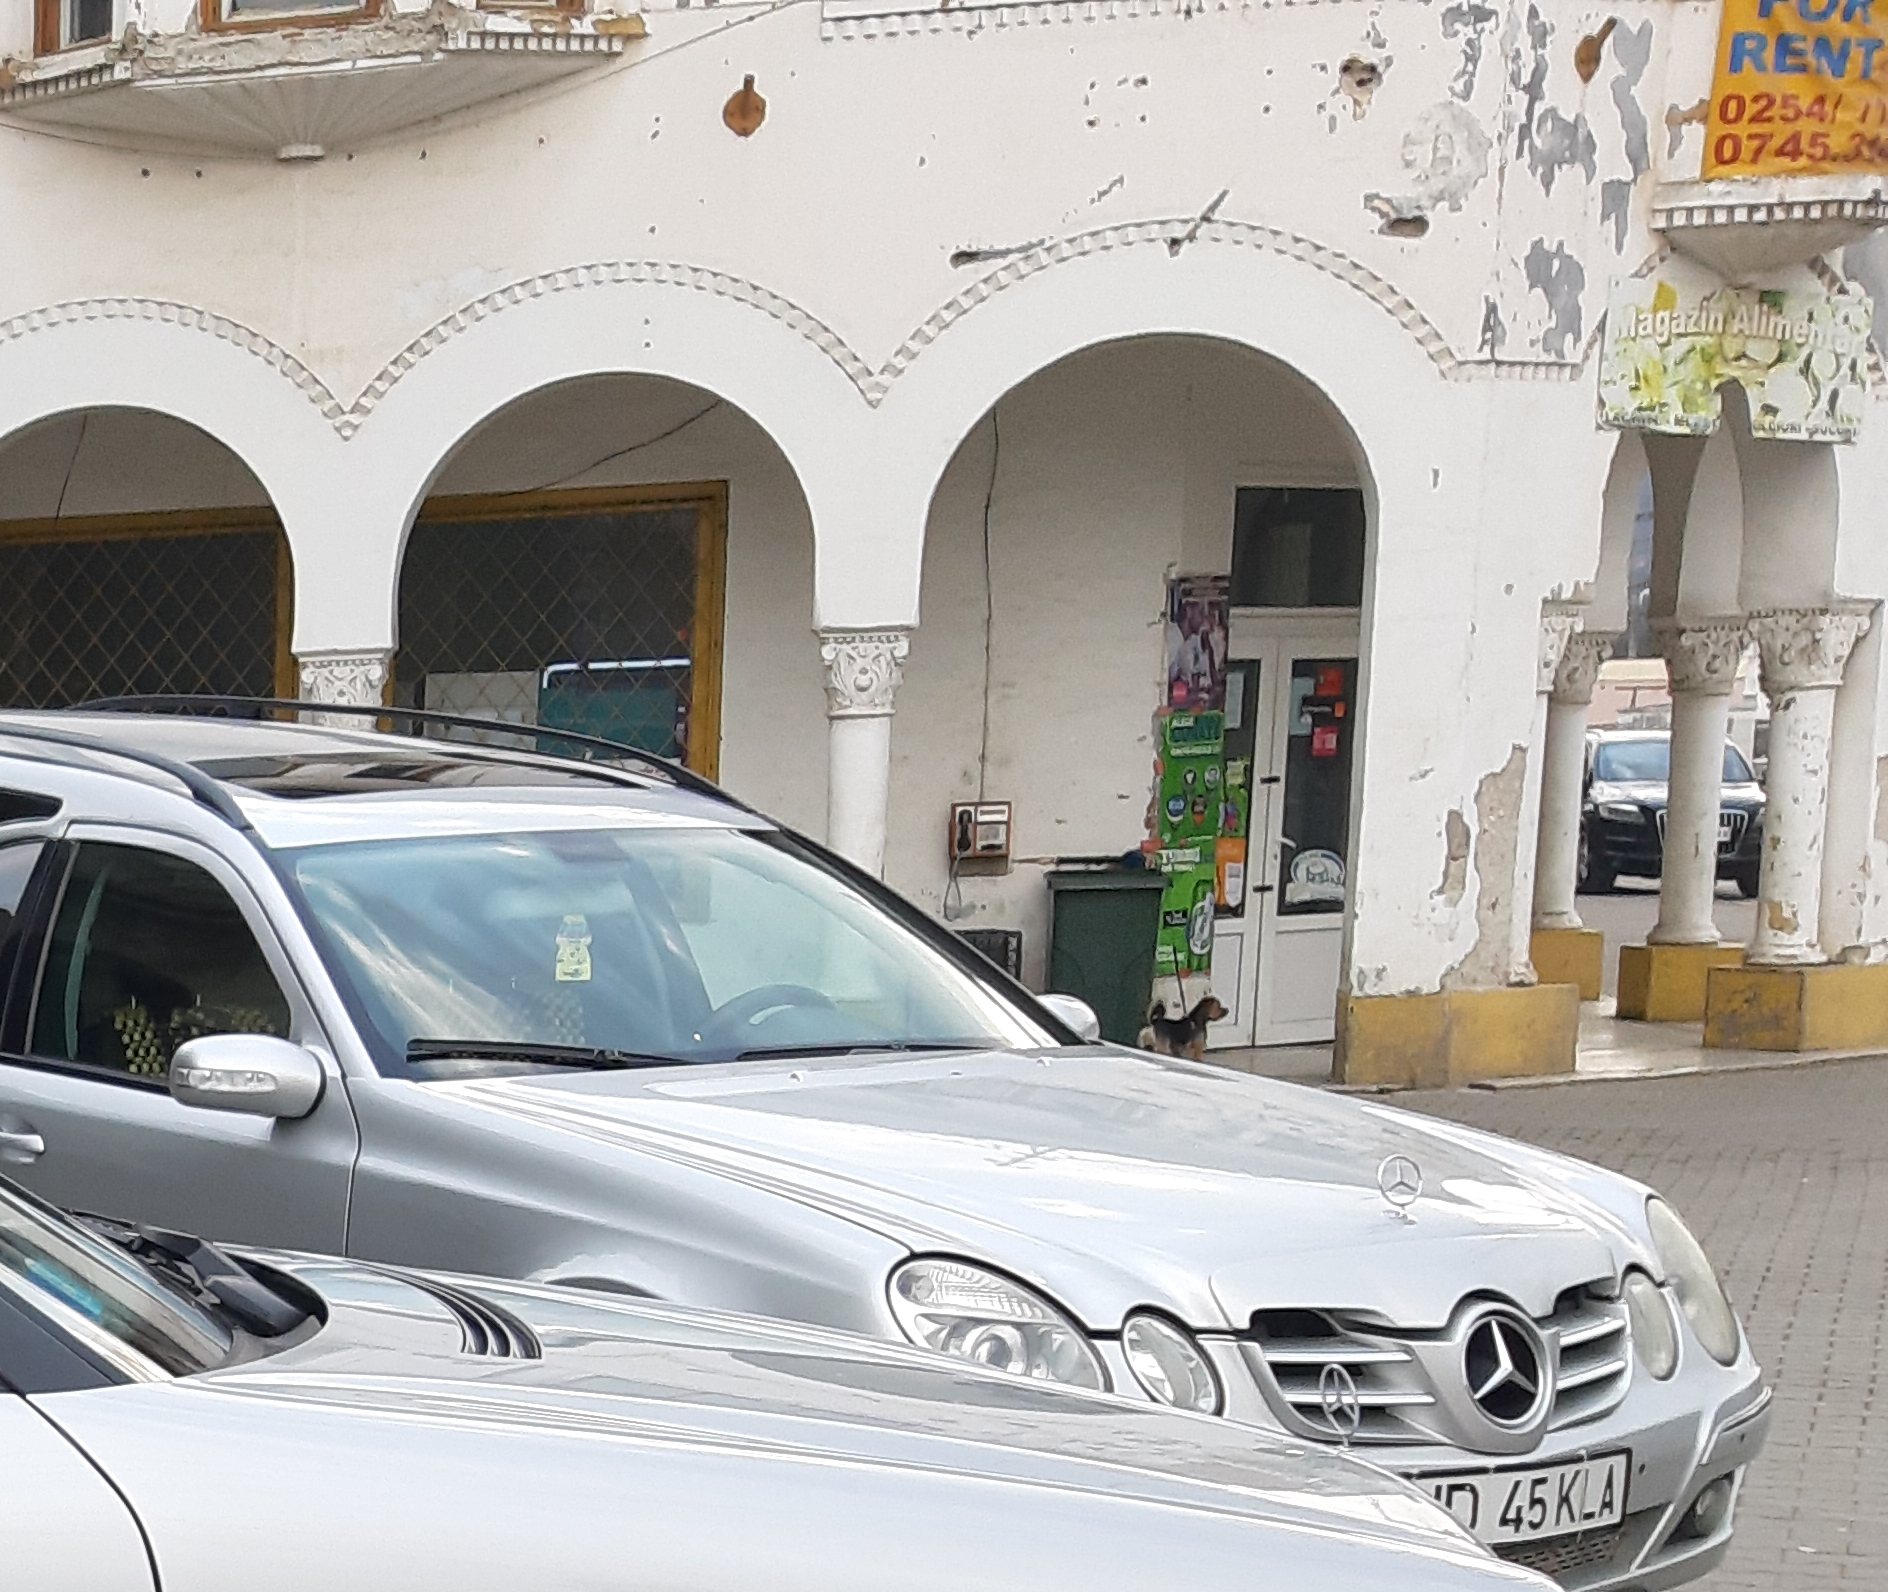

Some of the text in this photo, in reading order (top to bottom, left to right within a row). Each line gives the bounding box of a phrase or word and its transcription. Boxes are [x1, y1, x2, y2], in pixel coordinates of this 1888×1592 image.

[1729, 32, 1885, 79] RENT
[1734, 303, 1864, 355] Alimena
[1499, 1476, 1549, 1534] 45
[1555, 1463, 1616, 1527] KLA
